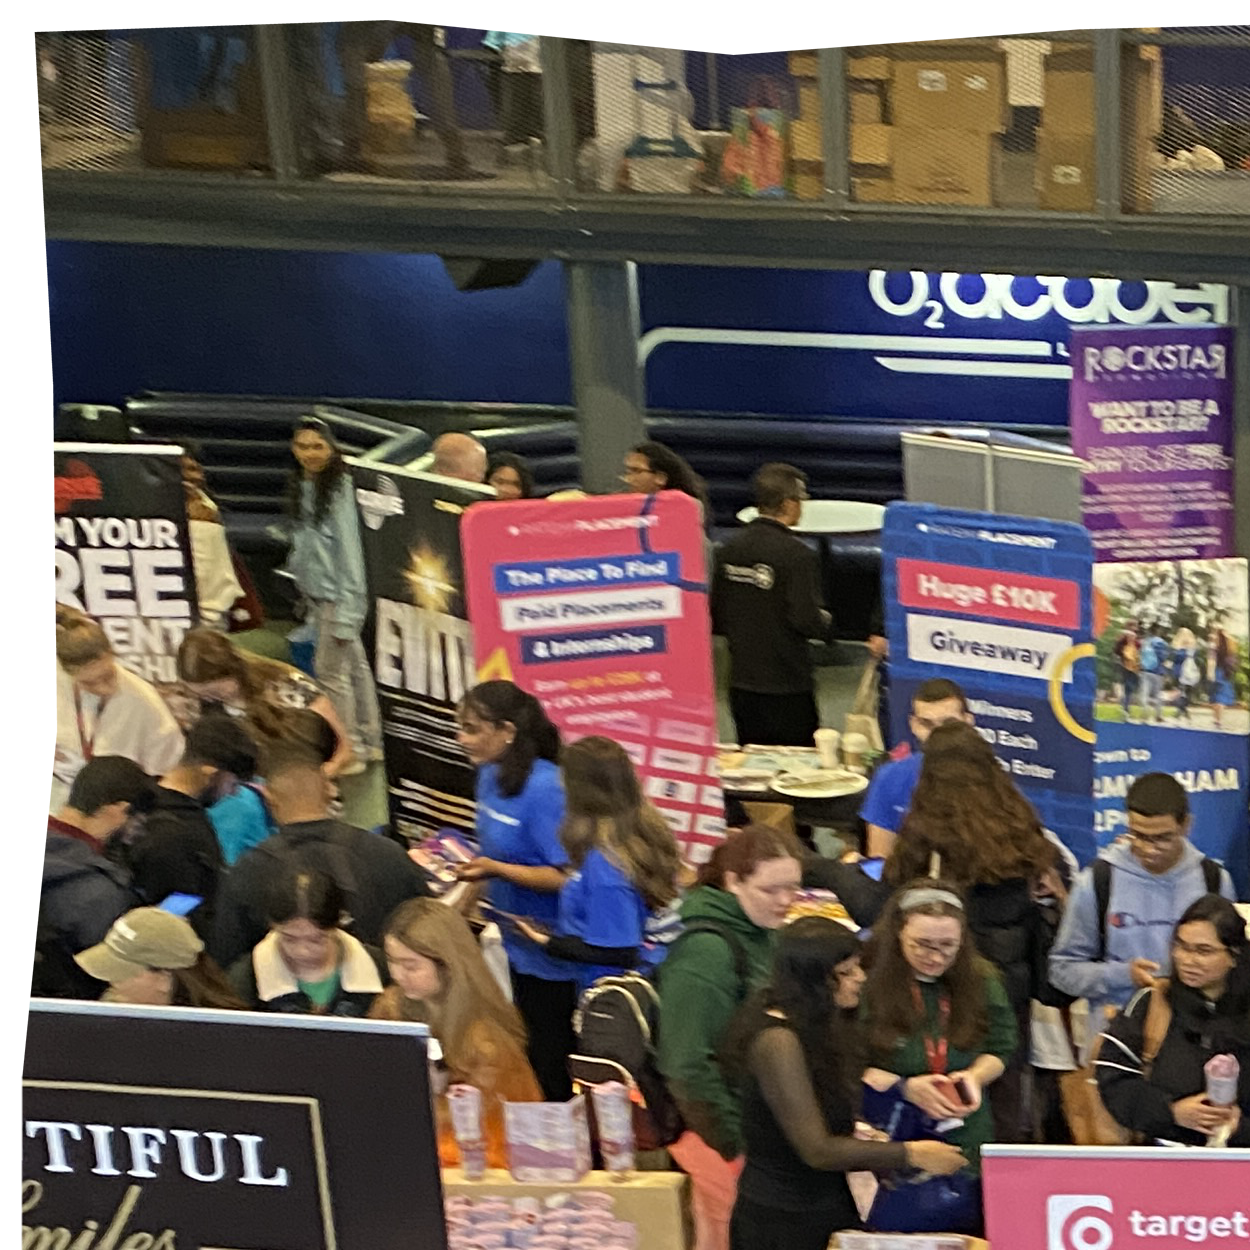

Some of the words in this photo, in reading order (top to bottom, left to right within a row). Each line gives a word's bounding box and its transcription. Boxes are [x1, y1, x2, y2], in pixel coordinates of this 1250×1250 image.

[77, 517, 180, 548] YOUR
[21, 548, 192, 616] REE
[505, 569, 544, 586] The
[546, 567, 598, 583] Place
[600, 563, 624, 579] To
[625, 560, 668, 577] Find
[516, 606, 557, 622] Paid
[560, 599, 665, 617] Placements
[917, 574, 987, 607] Huge
[990, 584, 1059, 615] £10K
[21, 615, 191, 656] TUENT
[551, 633, 655, 653] Internships
[930, 631, 1048, 671] Giveaway
[1130, 748, 1151, 762] to
[24, 1120, 288, 1187] TIFUL
